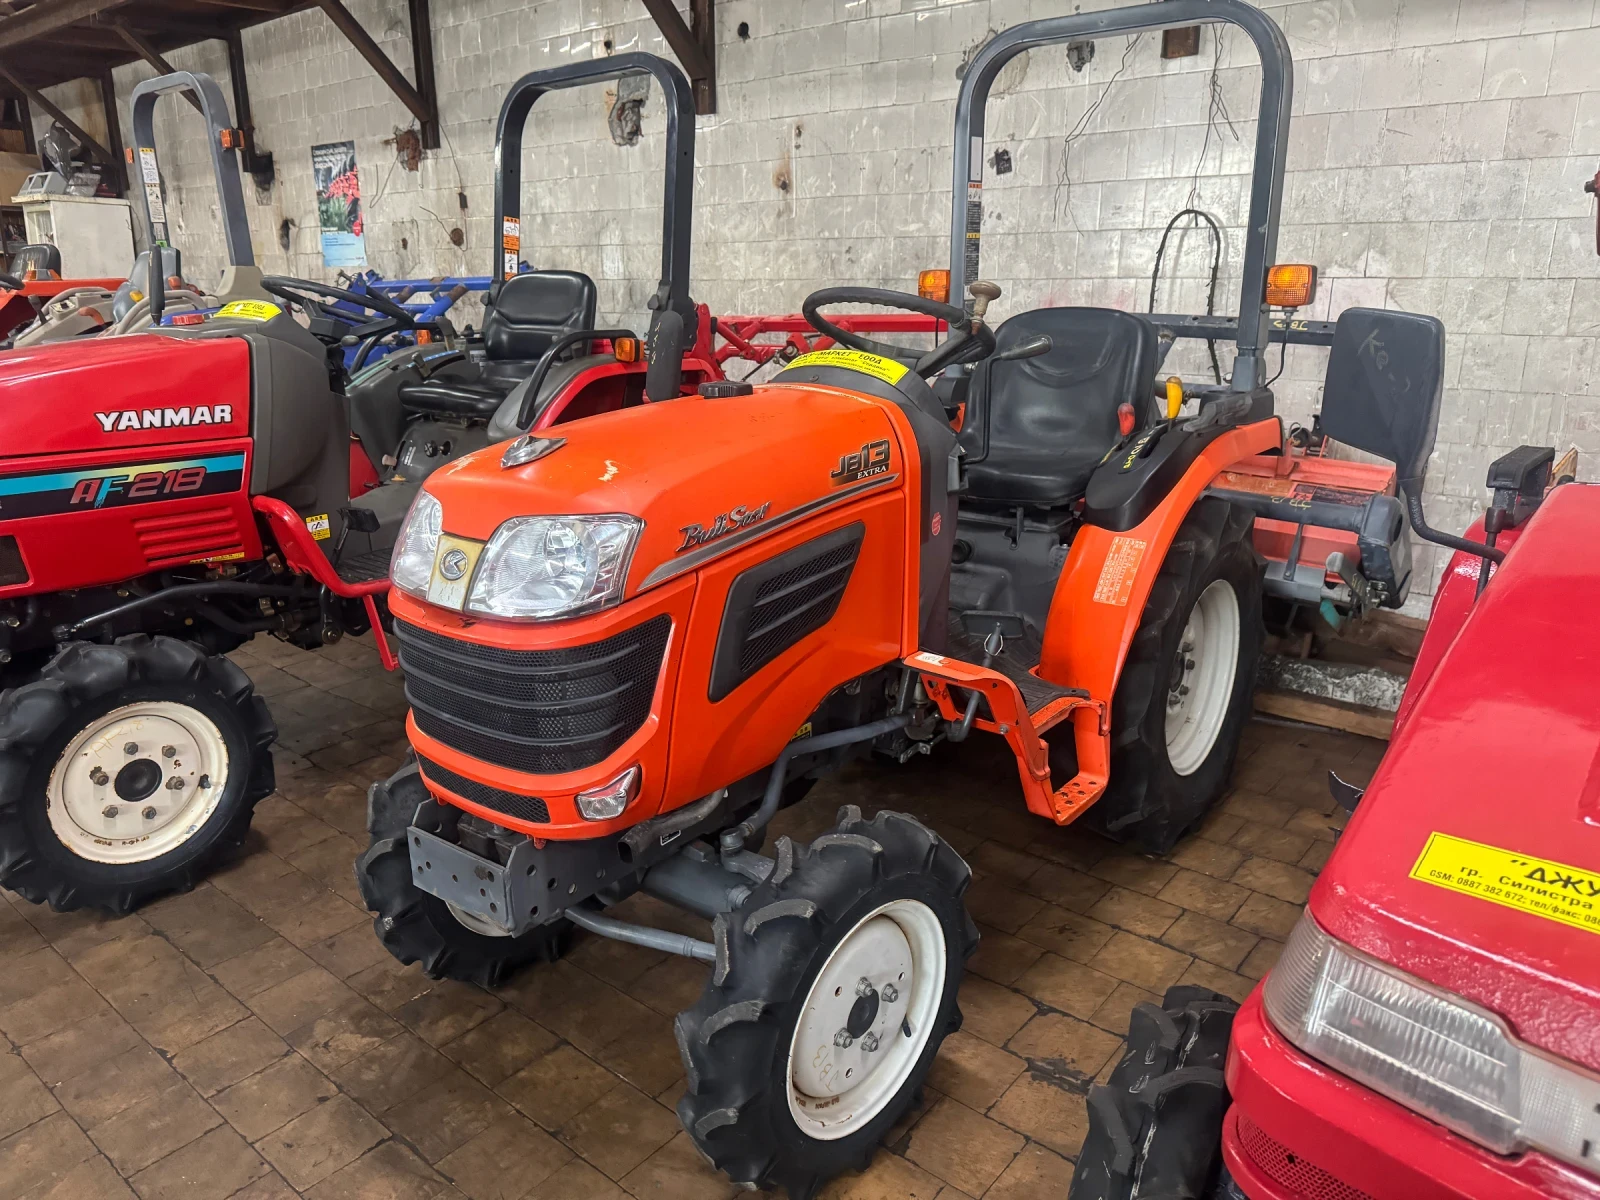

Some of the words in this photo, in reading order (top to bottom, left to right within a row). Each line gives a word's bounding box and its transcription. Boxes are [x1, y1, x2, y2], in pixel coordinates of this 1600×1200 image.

[1273, 319, 1309, 331] JB3
[95, 404, 232, 432] YANMAR
[830, 439, 890, 478] JB13
[857, 465, 887, 479] EXTRA
[70, 467, 207, 508] AF218
[1429, 869, 1455, 883] GSM:
[1457, 877, 1482, 890] 0887
[1483, 885, 1502, 896] 382
[1460, 866, 1483, 878] гр.
[1499, 875, 1593, 910] Силистра
[811, 1044, 841, 1092] JB13
